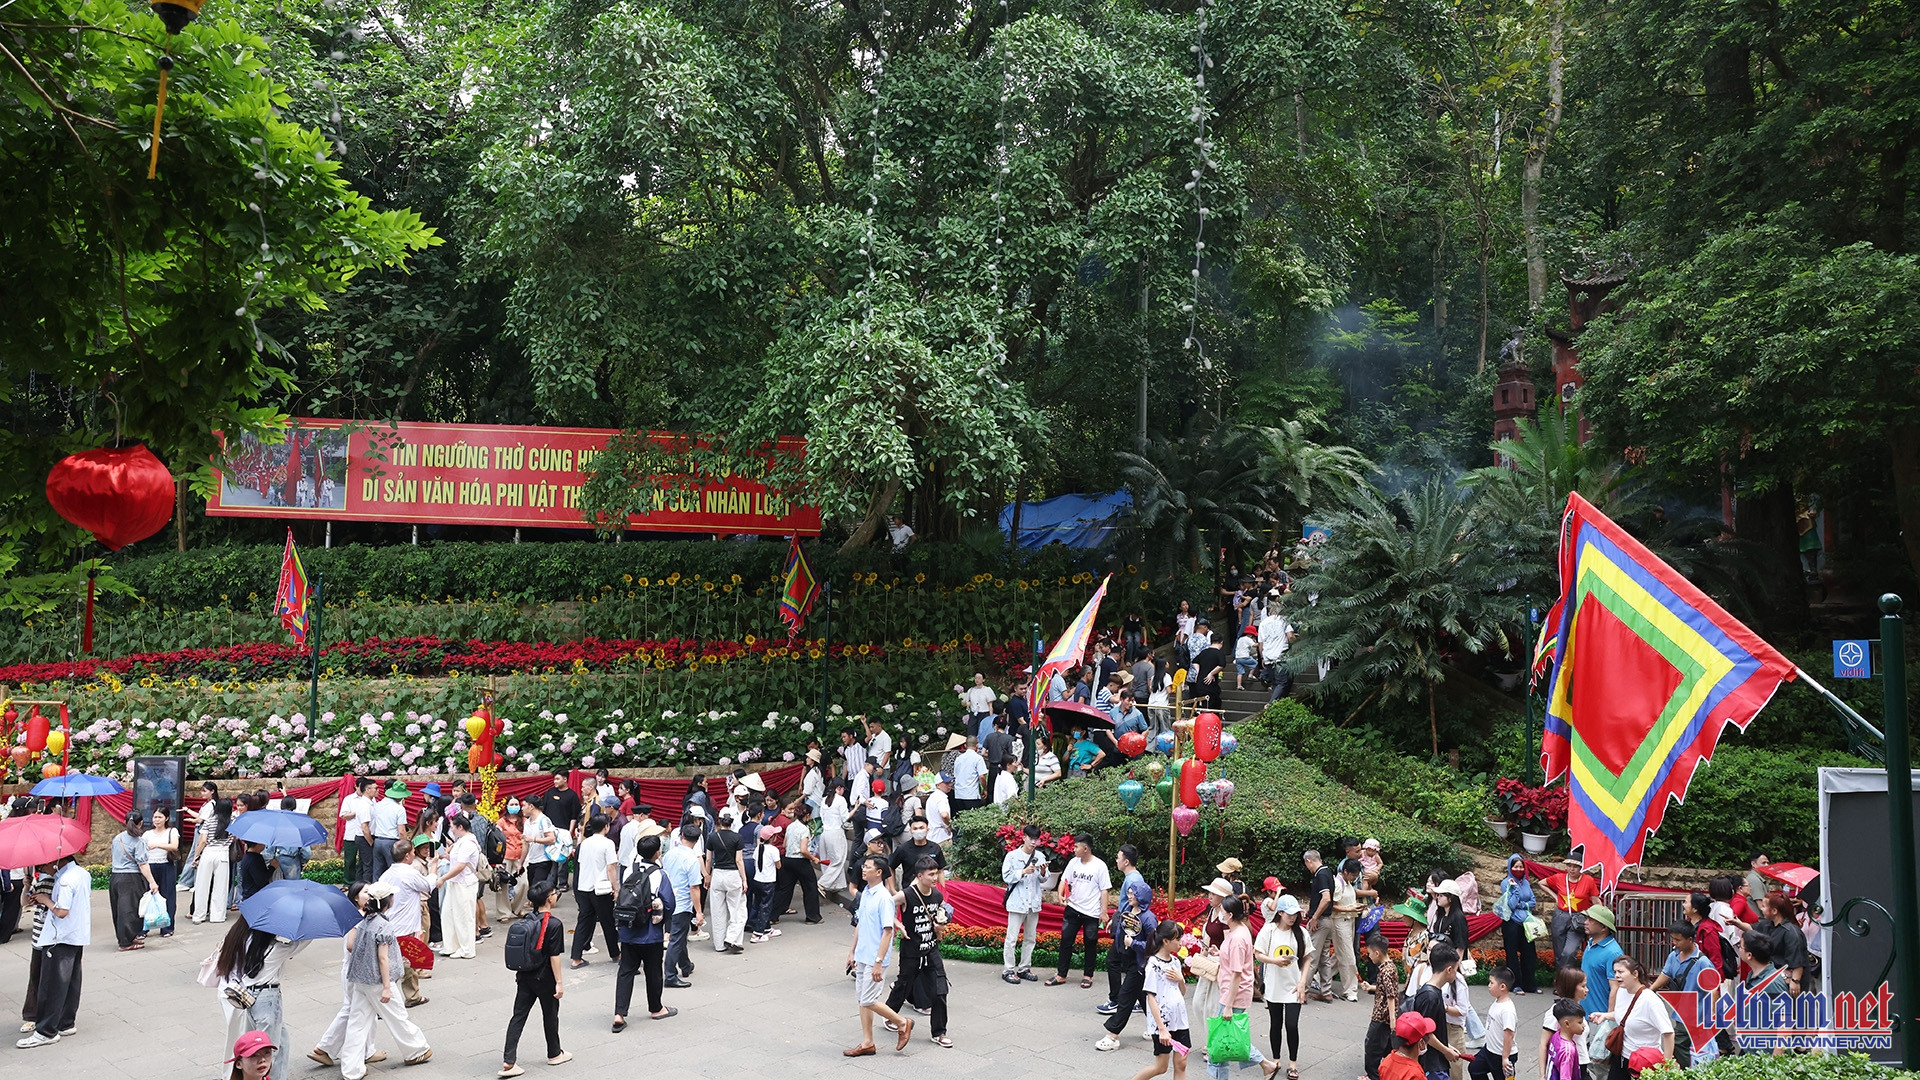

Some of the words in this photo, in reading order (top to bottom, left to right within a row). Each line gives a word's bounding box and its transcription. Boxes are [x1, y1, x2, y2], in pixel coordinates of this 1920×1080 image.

[421, 440, 490, 470] NGƯỠNG
[493, 441, 526, 471] THỜ
[528, 443, 573, 473] CÚNG
[362, 478, 379, 502] DI
[383, 471, 418, 503] SẢN
[422, 475, 455, 504] VĂN
[459, 477, 492, 506] HÓA
[496, 483, 524, 507] PHI
[528, 479, 558, 513] VẬT
[705, 486, 751, 515] NHÂN
[1840, 667, 1865, 677] vidifi
